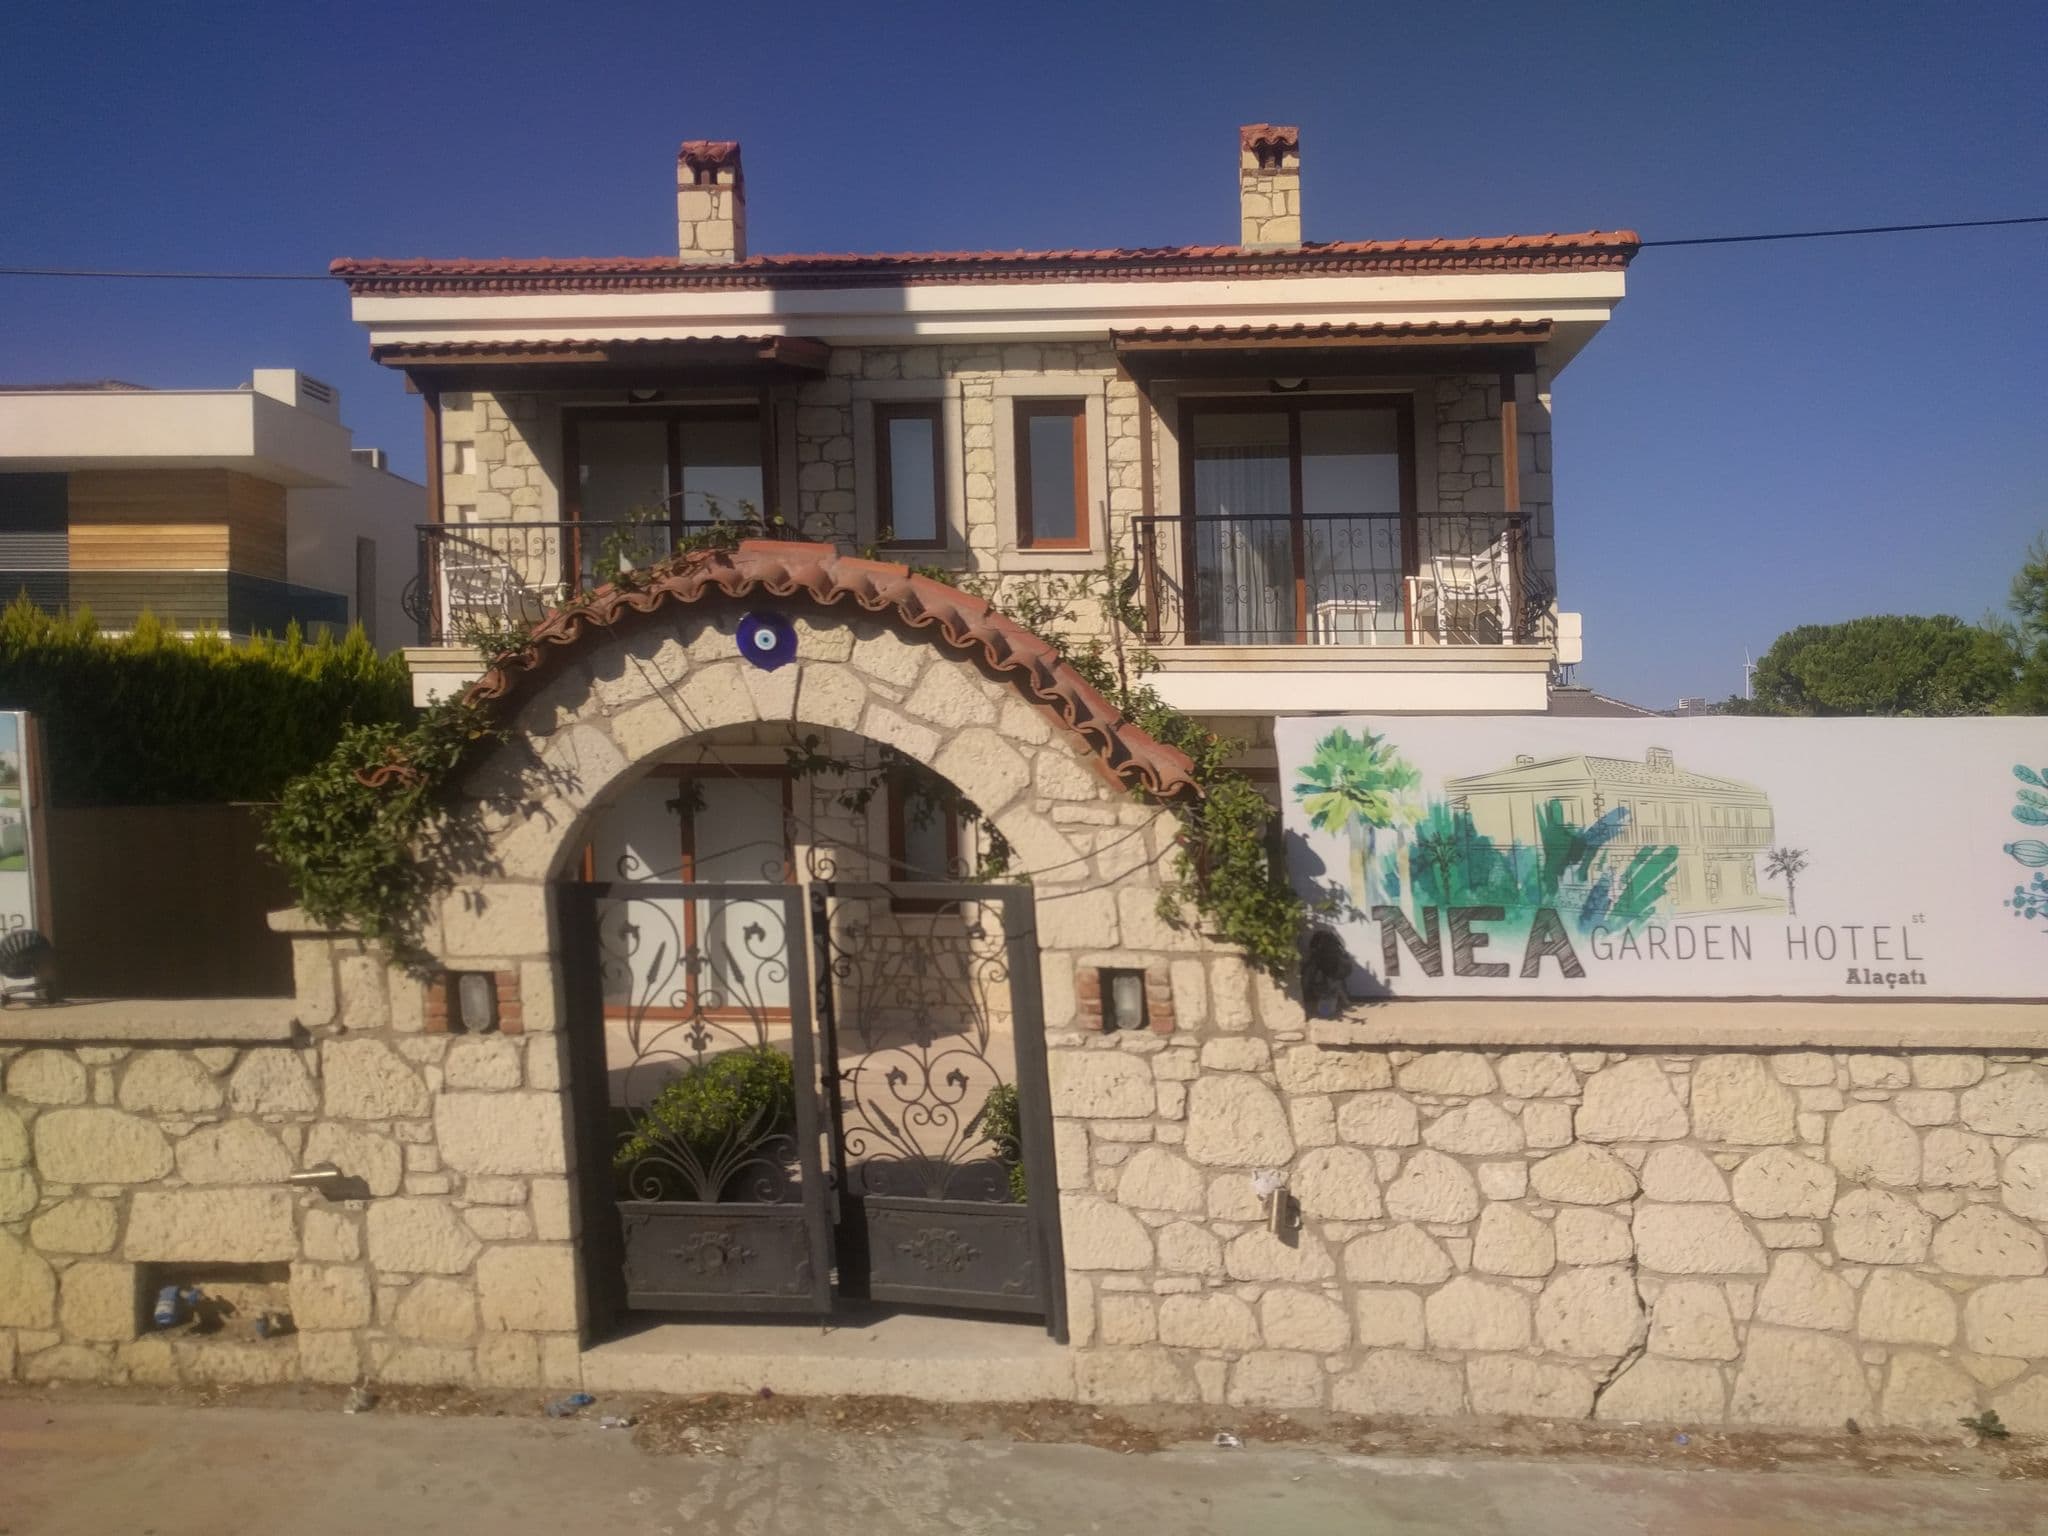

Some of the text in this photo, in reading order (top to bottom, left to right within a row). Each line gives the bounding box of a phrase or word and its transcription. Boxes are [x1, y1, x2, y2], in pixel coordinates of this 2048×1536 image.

[1371, 905, 1586, 979] NEA
[1591, 925, 1752, 961] GARDEN
[1786, 925, 1924, 961] HOTEL
[1845, 967, 1927, 990] Alaçatı
